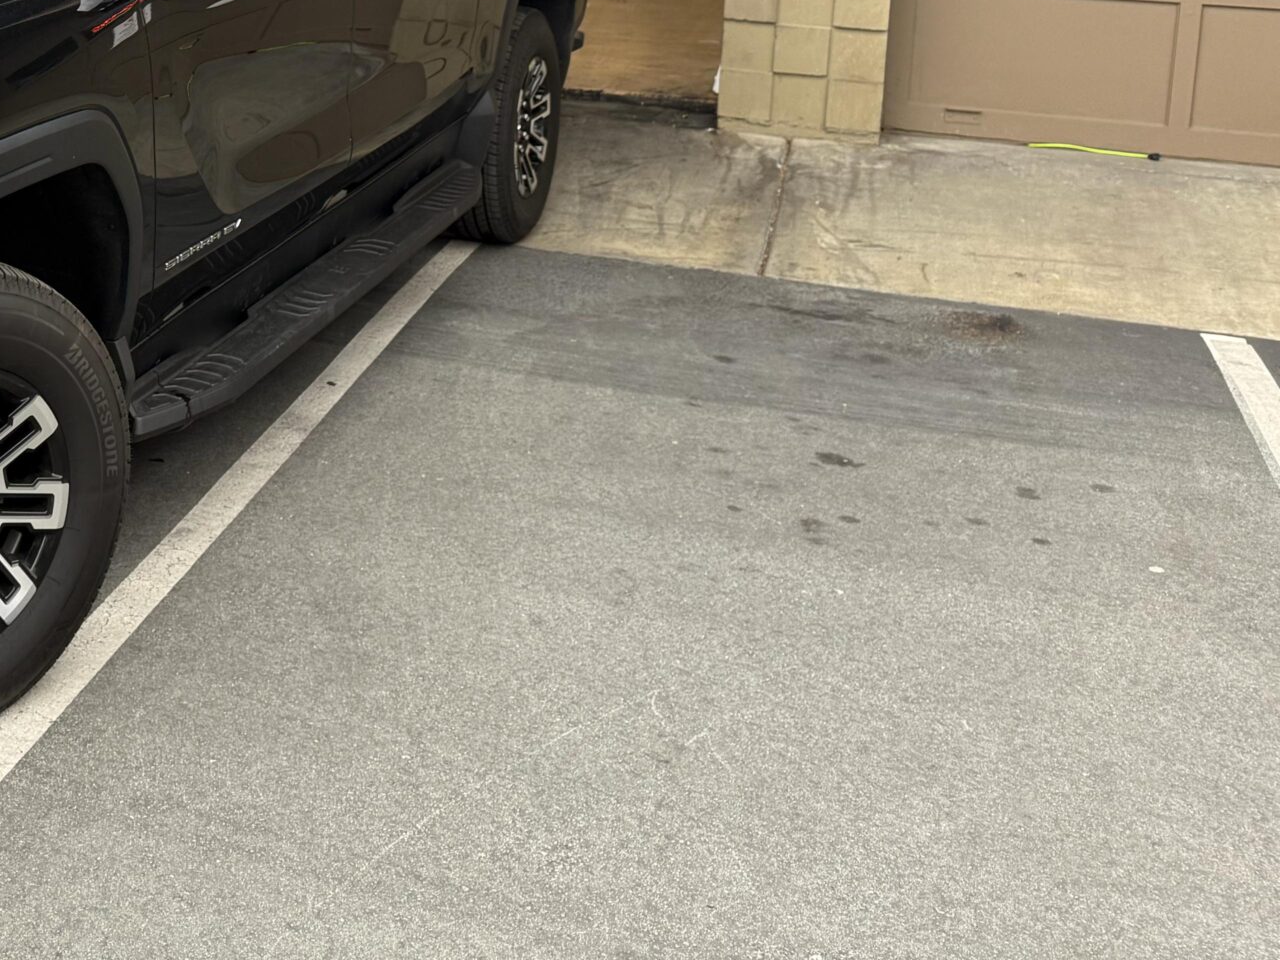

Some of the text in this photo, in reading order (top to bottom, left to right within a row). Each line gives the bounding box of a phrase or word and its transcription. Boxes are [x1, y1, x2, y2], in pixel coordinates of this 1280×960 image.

[165, 218, 242, 271] SIERRA EV
[63, 342, 119, 478] BRIDGESTONE
